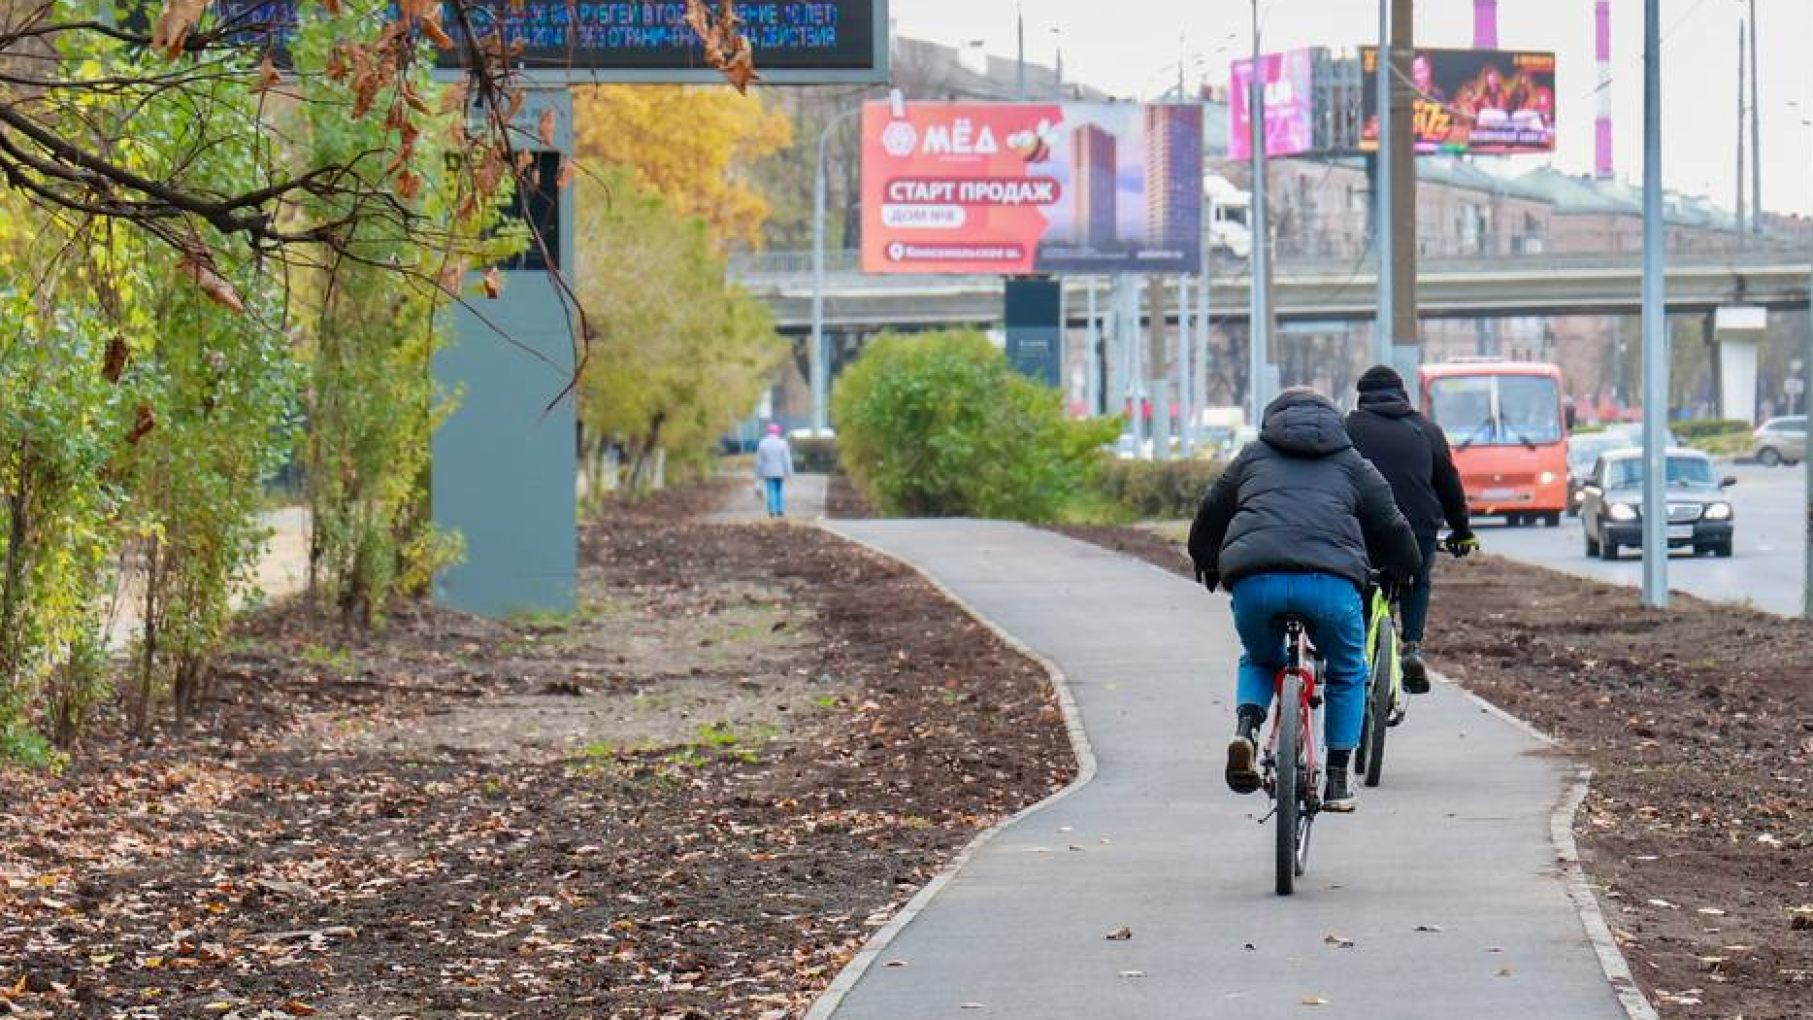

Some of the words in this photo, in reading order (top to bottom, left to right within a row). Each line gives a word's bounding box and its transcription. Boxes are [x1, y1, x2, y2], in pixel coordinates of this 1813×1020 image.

[922, 116, 998, 154] МЁД
[890, 180, 955, 201] СТАРТ
[959, 180, 1053, 204] ПРОДАЖ
[891, 209, 927, 223] ДОМ
